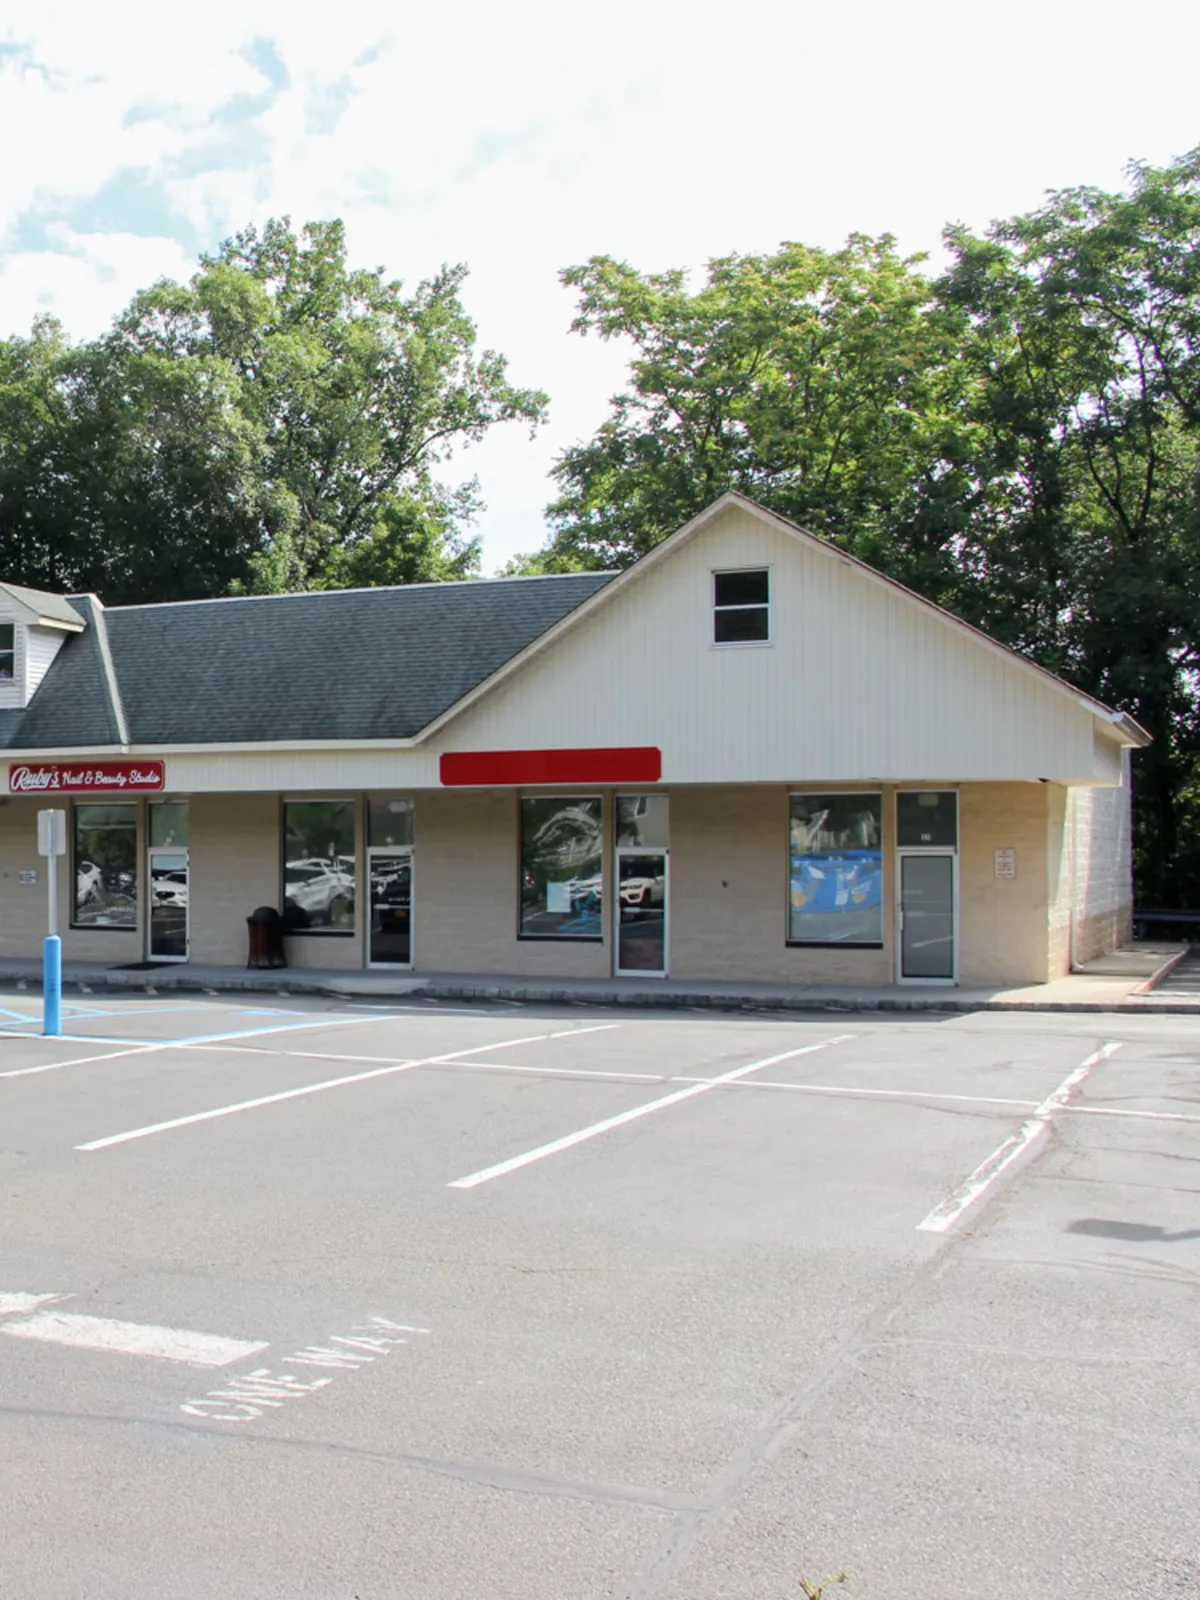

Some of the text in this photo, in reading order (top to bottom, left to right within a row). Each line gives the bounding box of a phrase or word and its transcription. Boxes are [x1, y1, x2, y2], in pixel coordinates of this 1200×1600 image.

[11, 766, 60, 790] Ruby's
[85, 770, 94, 784] &
[95, 771, 127, 786] Beauty
[129, 769, 160, 784] Studio
[180, 1316, 432, 1421] ONE WAY
